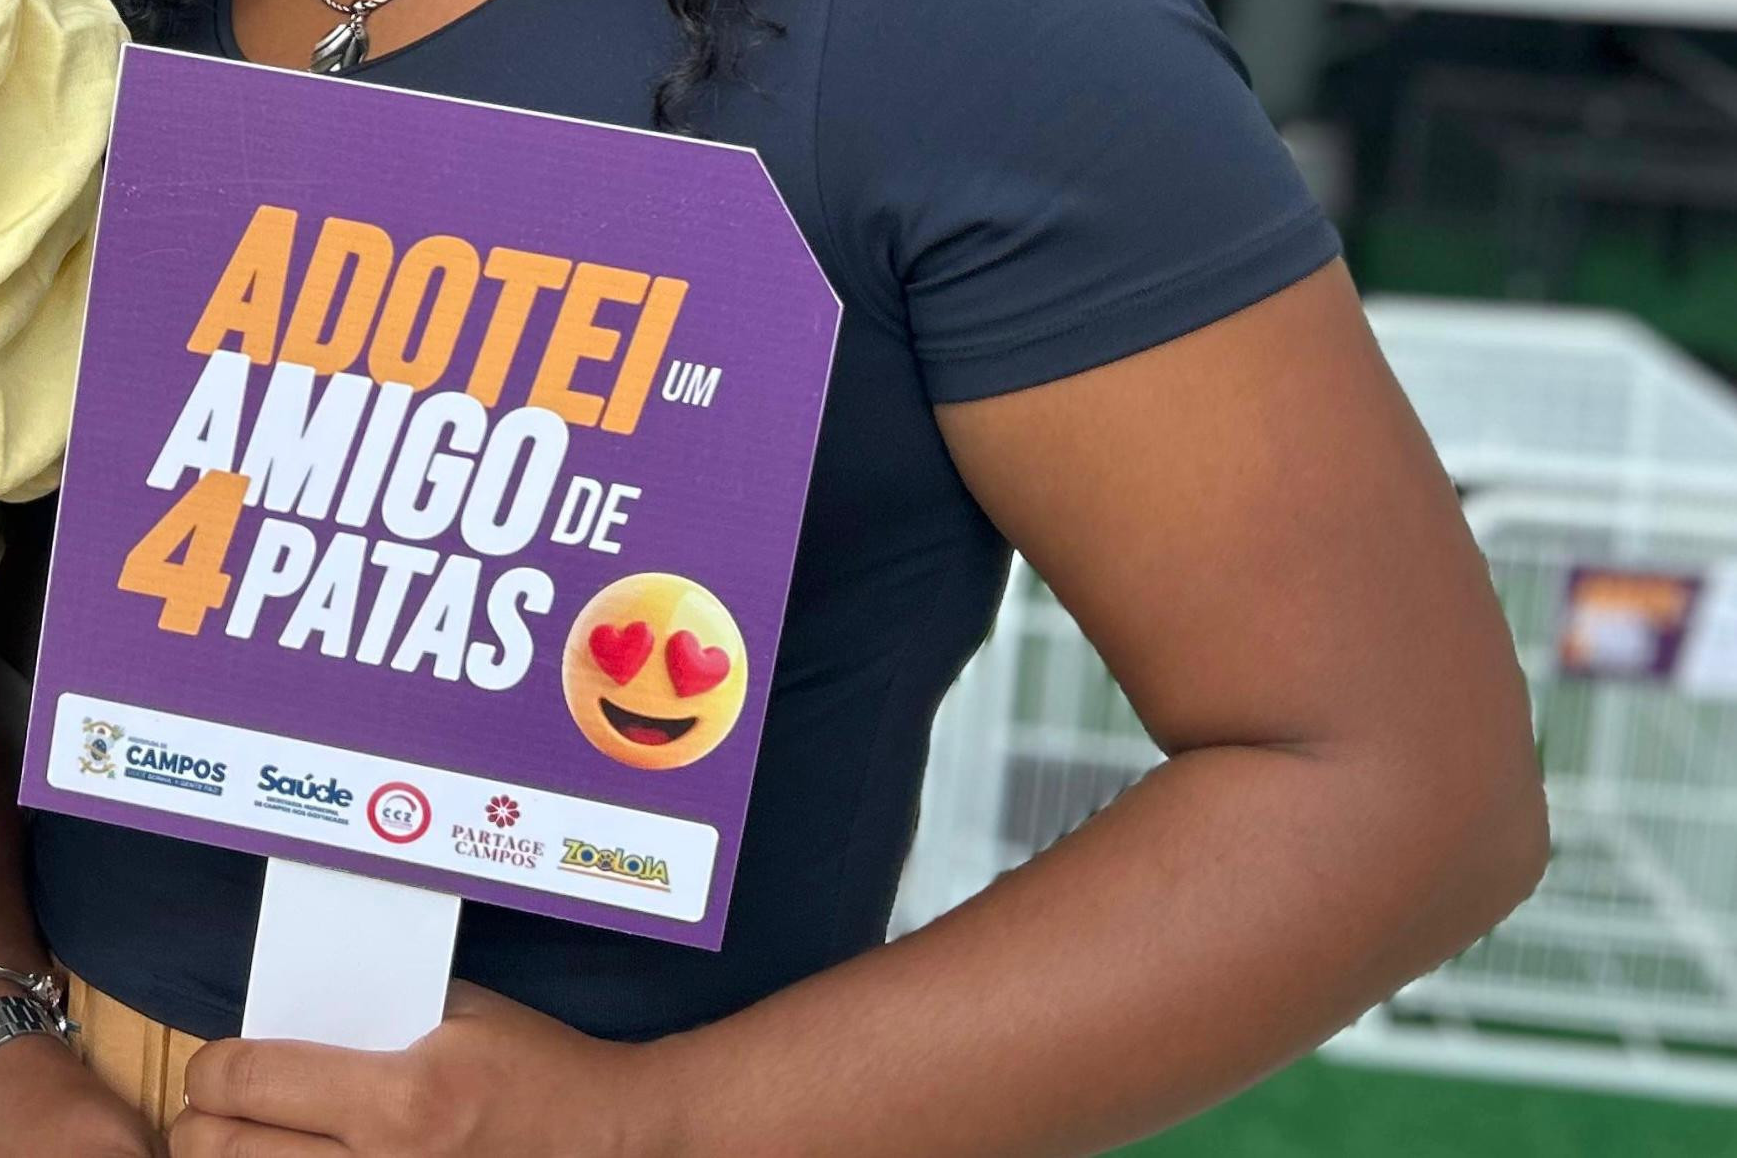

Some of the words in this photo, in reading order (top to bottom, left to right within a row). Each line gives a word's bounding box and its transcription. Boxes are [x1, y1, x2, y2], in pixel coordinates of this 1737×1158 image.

[188, 205, 688, 435] ADOTEI
[662, 360, 723, 408] UM
[146, 350, 570, 556] AMIGO
[551, 476, 642, 555] DE
[118, 469, 252, 636] 4
[225, 518, 554, 691] PATAS
[126, 745, 228, 783] CAMPOS
[257, 764, 354, 808] Saúde
[452, 824, 544, 857] PARTAGE
[454, 841, 537, 869] CAMPOS
